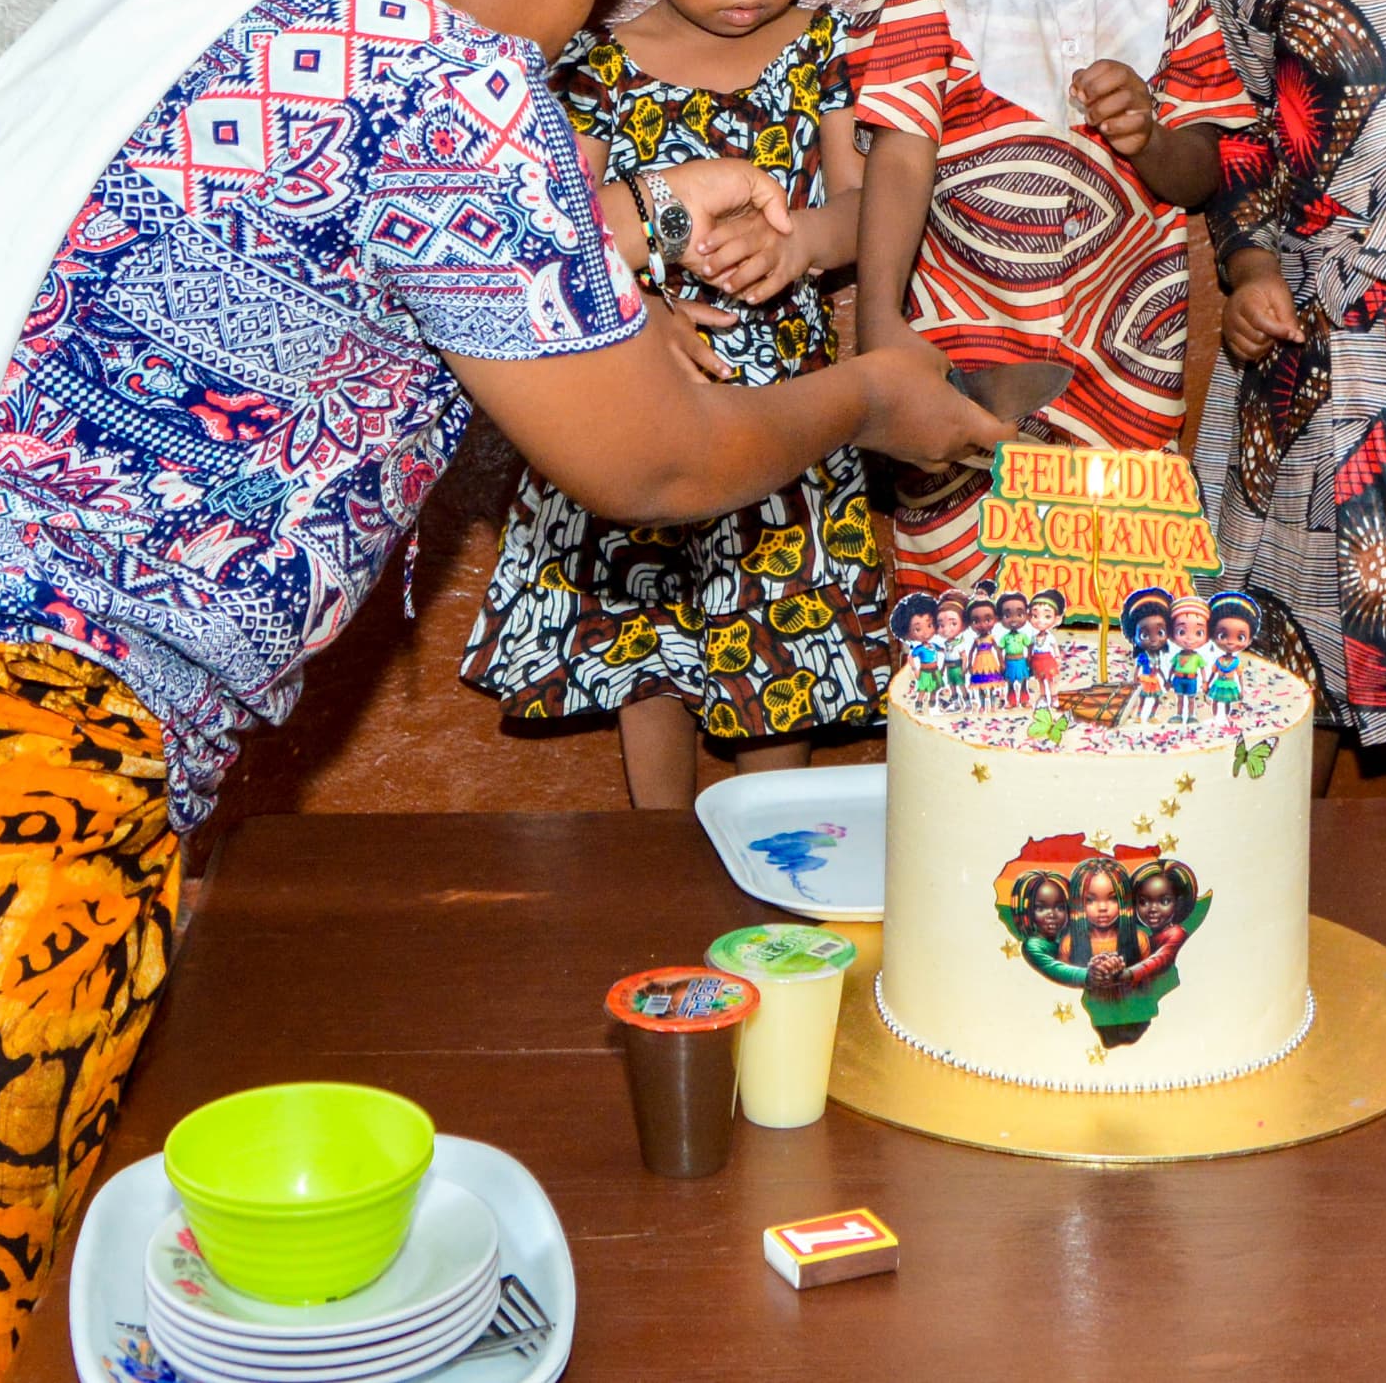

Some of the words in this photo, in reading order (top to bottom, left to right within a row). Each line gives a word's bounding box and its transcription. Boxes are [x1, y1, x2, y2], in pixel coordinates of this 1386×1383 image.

[1007, 451, 1118, 500] FELIZ
[1126, 456, 1192, 506] DIA
[988, 504, 1038, 546] DA
[1048, 511, 1211, 569] CRIANÇA
